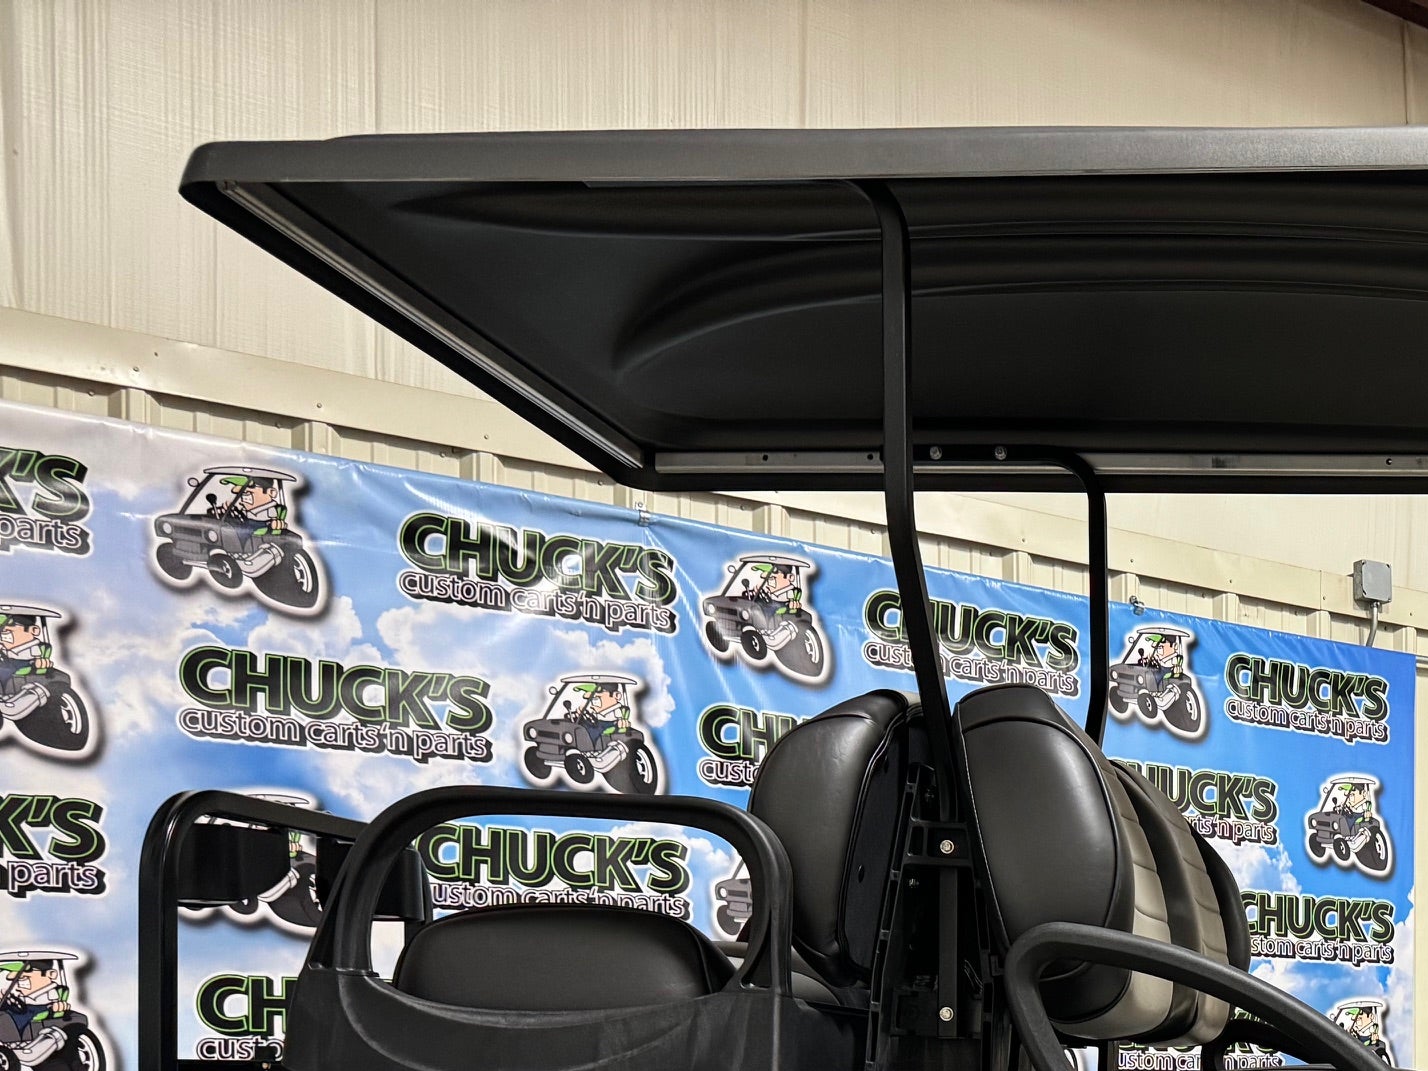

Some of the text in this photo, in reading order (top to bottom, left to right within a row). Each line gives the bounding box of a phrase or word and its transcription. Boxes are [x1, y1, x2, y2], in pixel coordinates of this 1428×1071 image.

[399, 511, 679, 608] CHUCK'S
[399, 571, 510, 612] custom
[604, 600, 677, 634] parts
[178, 645, 494, 734] CHUCK'S
[1226, 653, 1390, 722] CHUCK'S
[179, 707, 303, 745] custom
[413, 729, 494, 764] parts
[1226, 698, 1291, 730] custom
[1344, 716, 1389, 744] parts
[416, 823, 691, 893] CHUCK'S
[1231, 820, 1277, 846] parts
[7, 860, 107, 897] parts
[432, 883, 522, 910] ustom
[1352, 942, 1394, 967] parts
[1118, 1050, 1176, 1071] ustom
